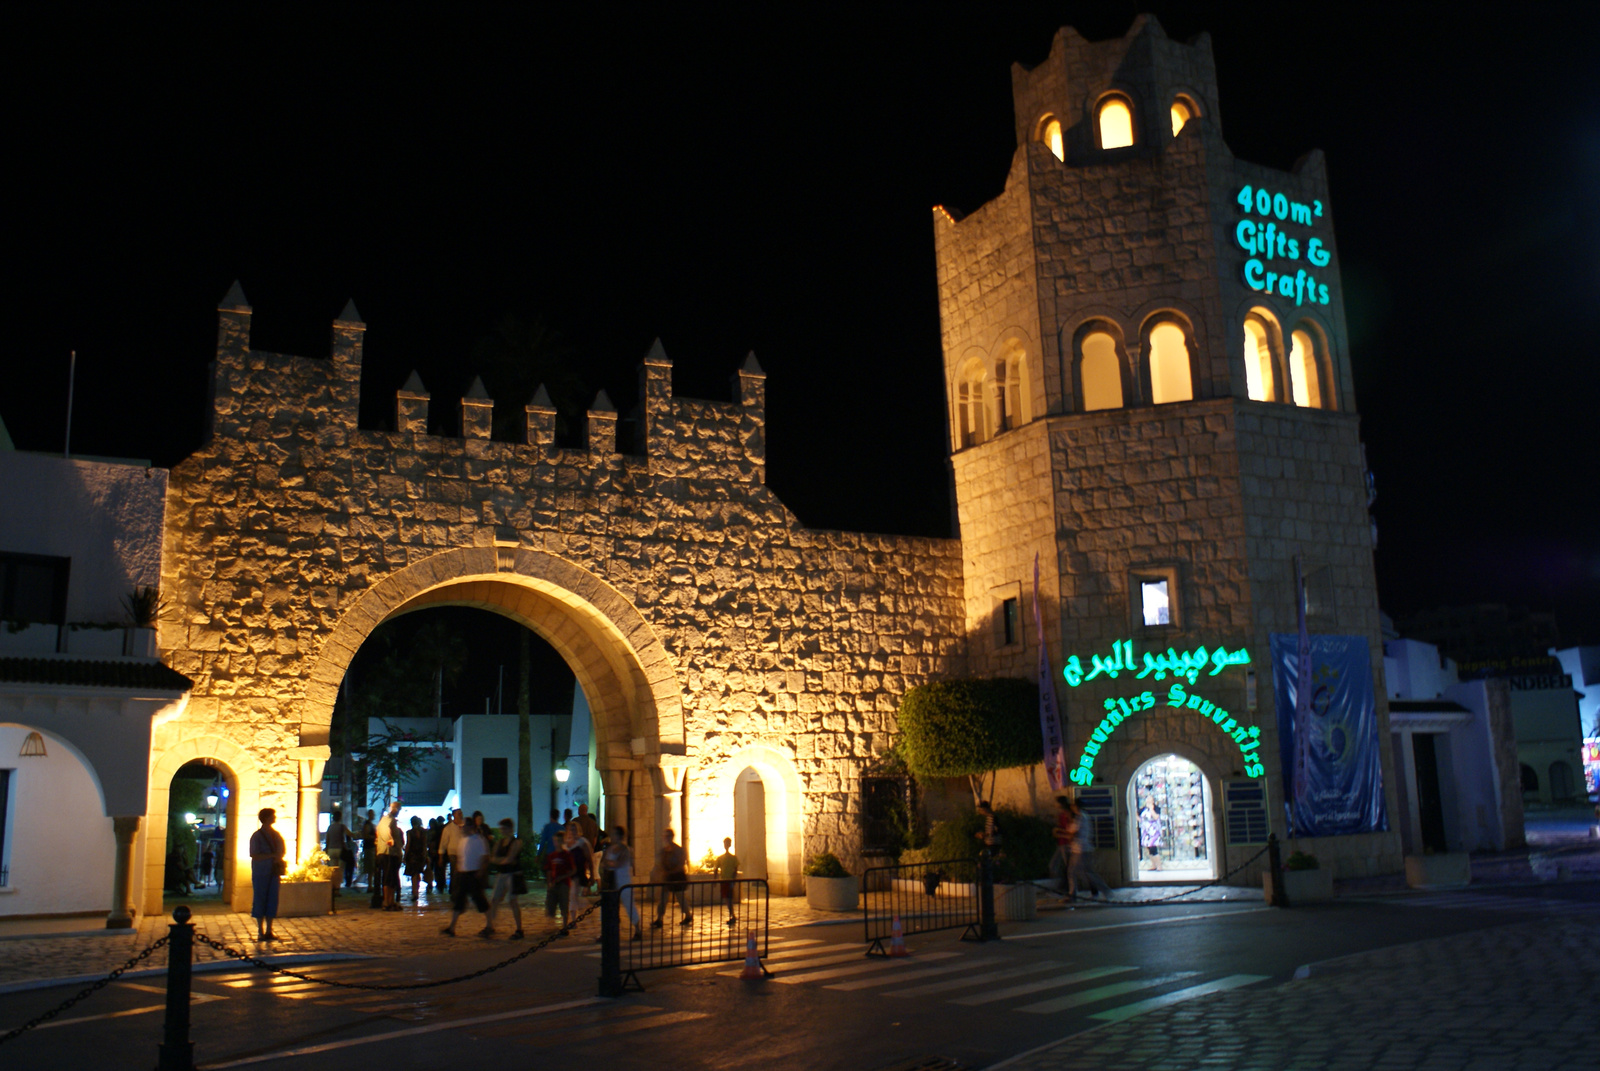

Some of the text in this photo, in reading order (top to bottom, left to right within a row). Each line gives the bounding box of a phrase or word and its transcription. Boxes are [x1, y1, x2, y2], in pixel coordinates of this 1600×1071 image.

[1236, 219, 1332, 268] Gifts &
[1244, 258, 1330, 307] Crafts
[1042, 692, 1060, 757] CENTER
[1070, 691, 1155, 786] Souvenirs
[1167, 683, 1264, 779] Souvenirs
